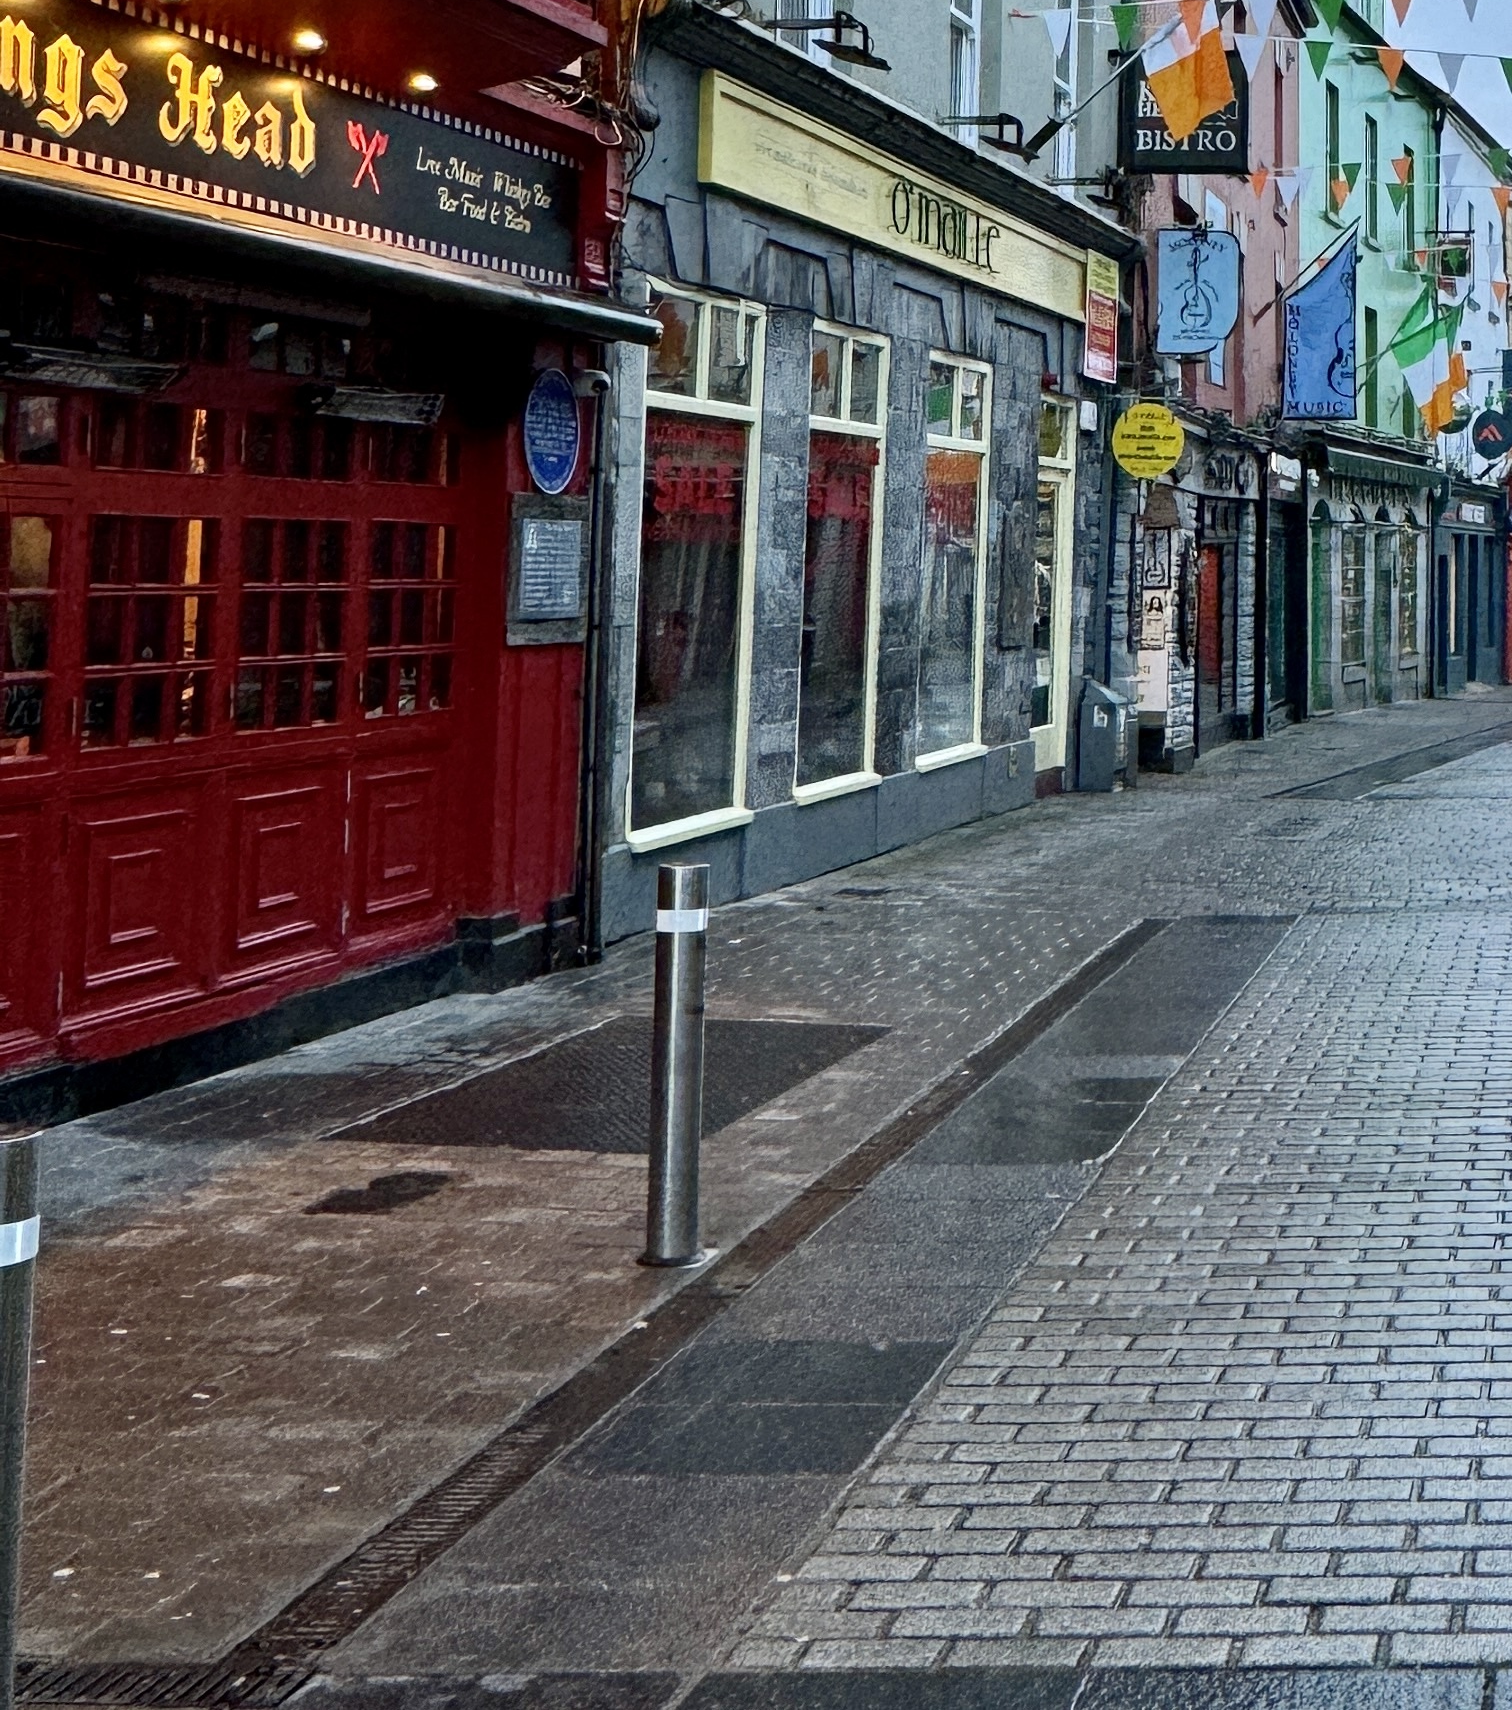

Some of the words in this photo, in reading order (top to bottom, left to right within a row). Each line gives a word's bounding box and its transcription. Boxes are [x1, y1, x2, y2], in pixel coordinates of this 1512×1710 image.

[158, 51, 317, 179] Head
[1136, 129, 1237, 151] BISTRO
[1286, 401, 1344, 414] MUSIC
